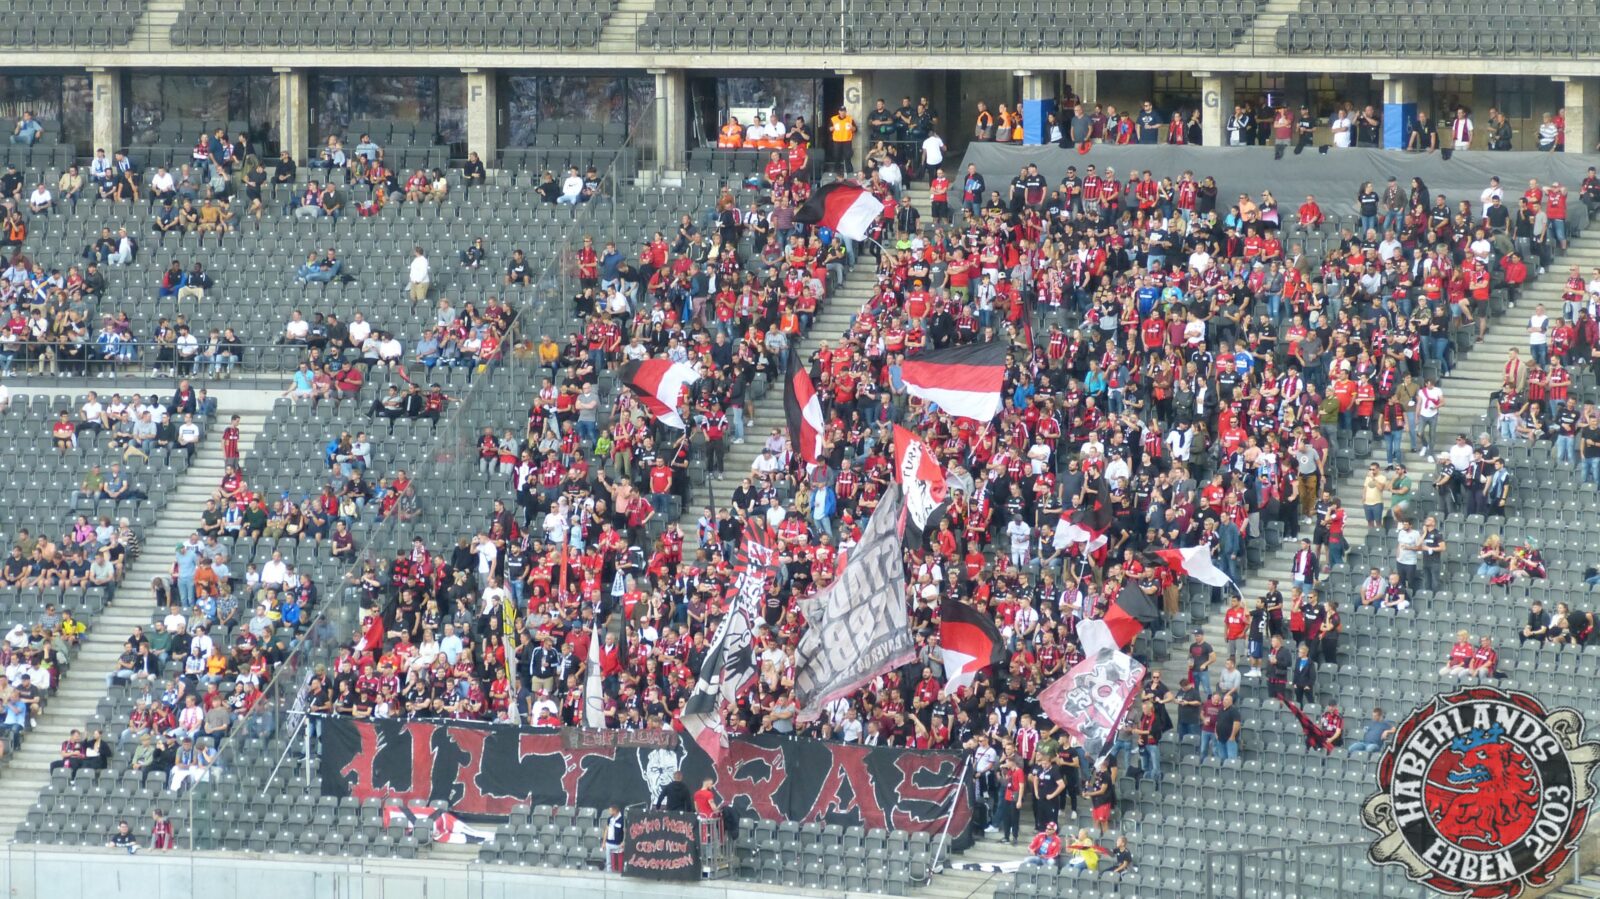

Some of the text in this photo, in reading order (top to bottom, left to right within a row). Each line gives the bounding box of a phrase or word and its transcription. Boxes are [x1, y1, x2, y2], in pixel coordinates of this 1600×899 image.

[97, 85, 107, 100] F
[471, 86, 482, 101] F
[846, 87, 860, 104] G
[1205, 91, 1219, 107] G
